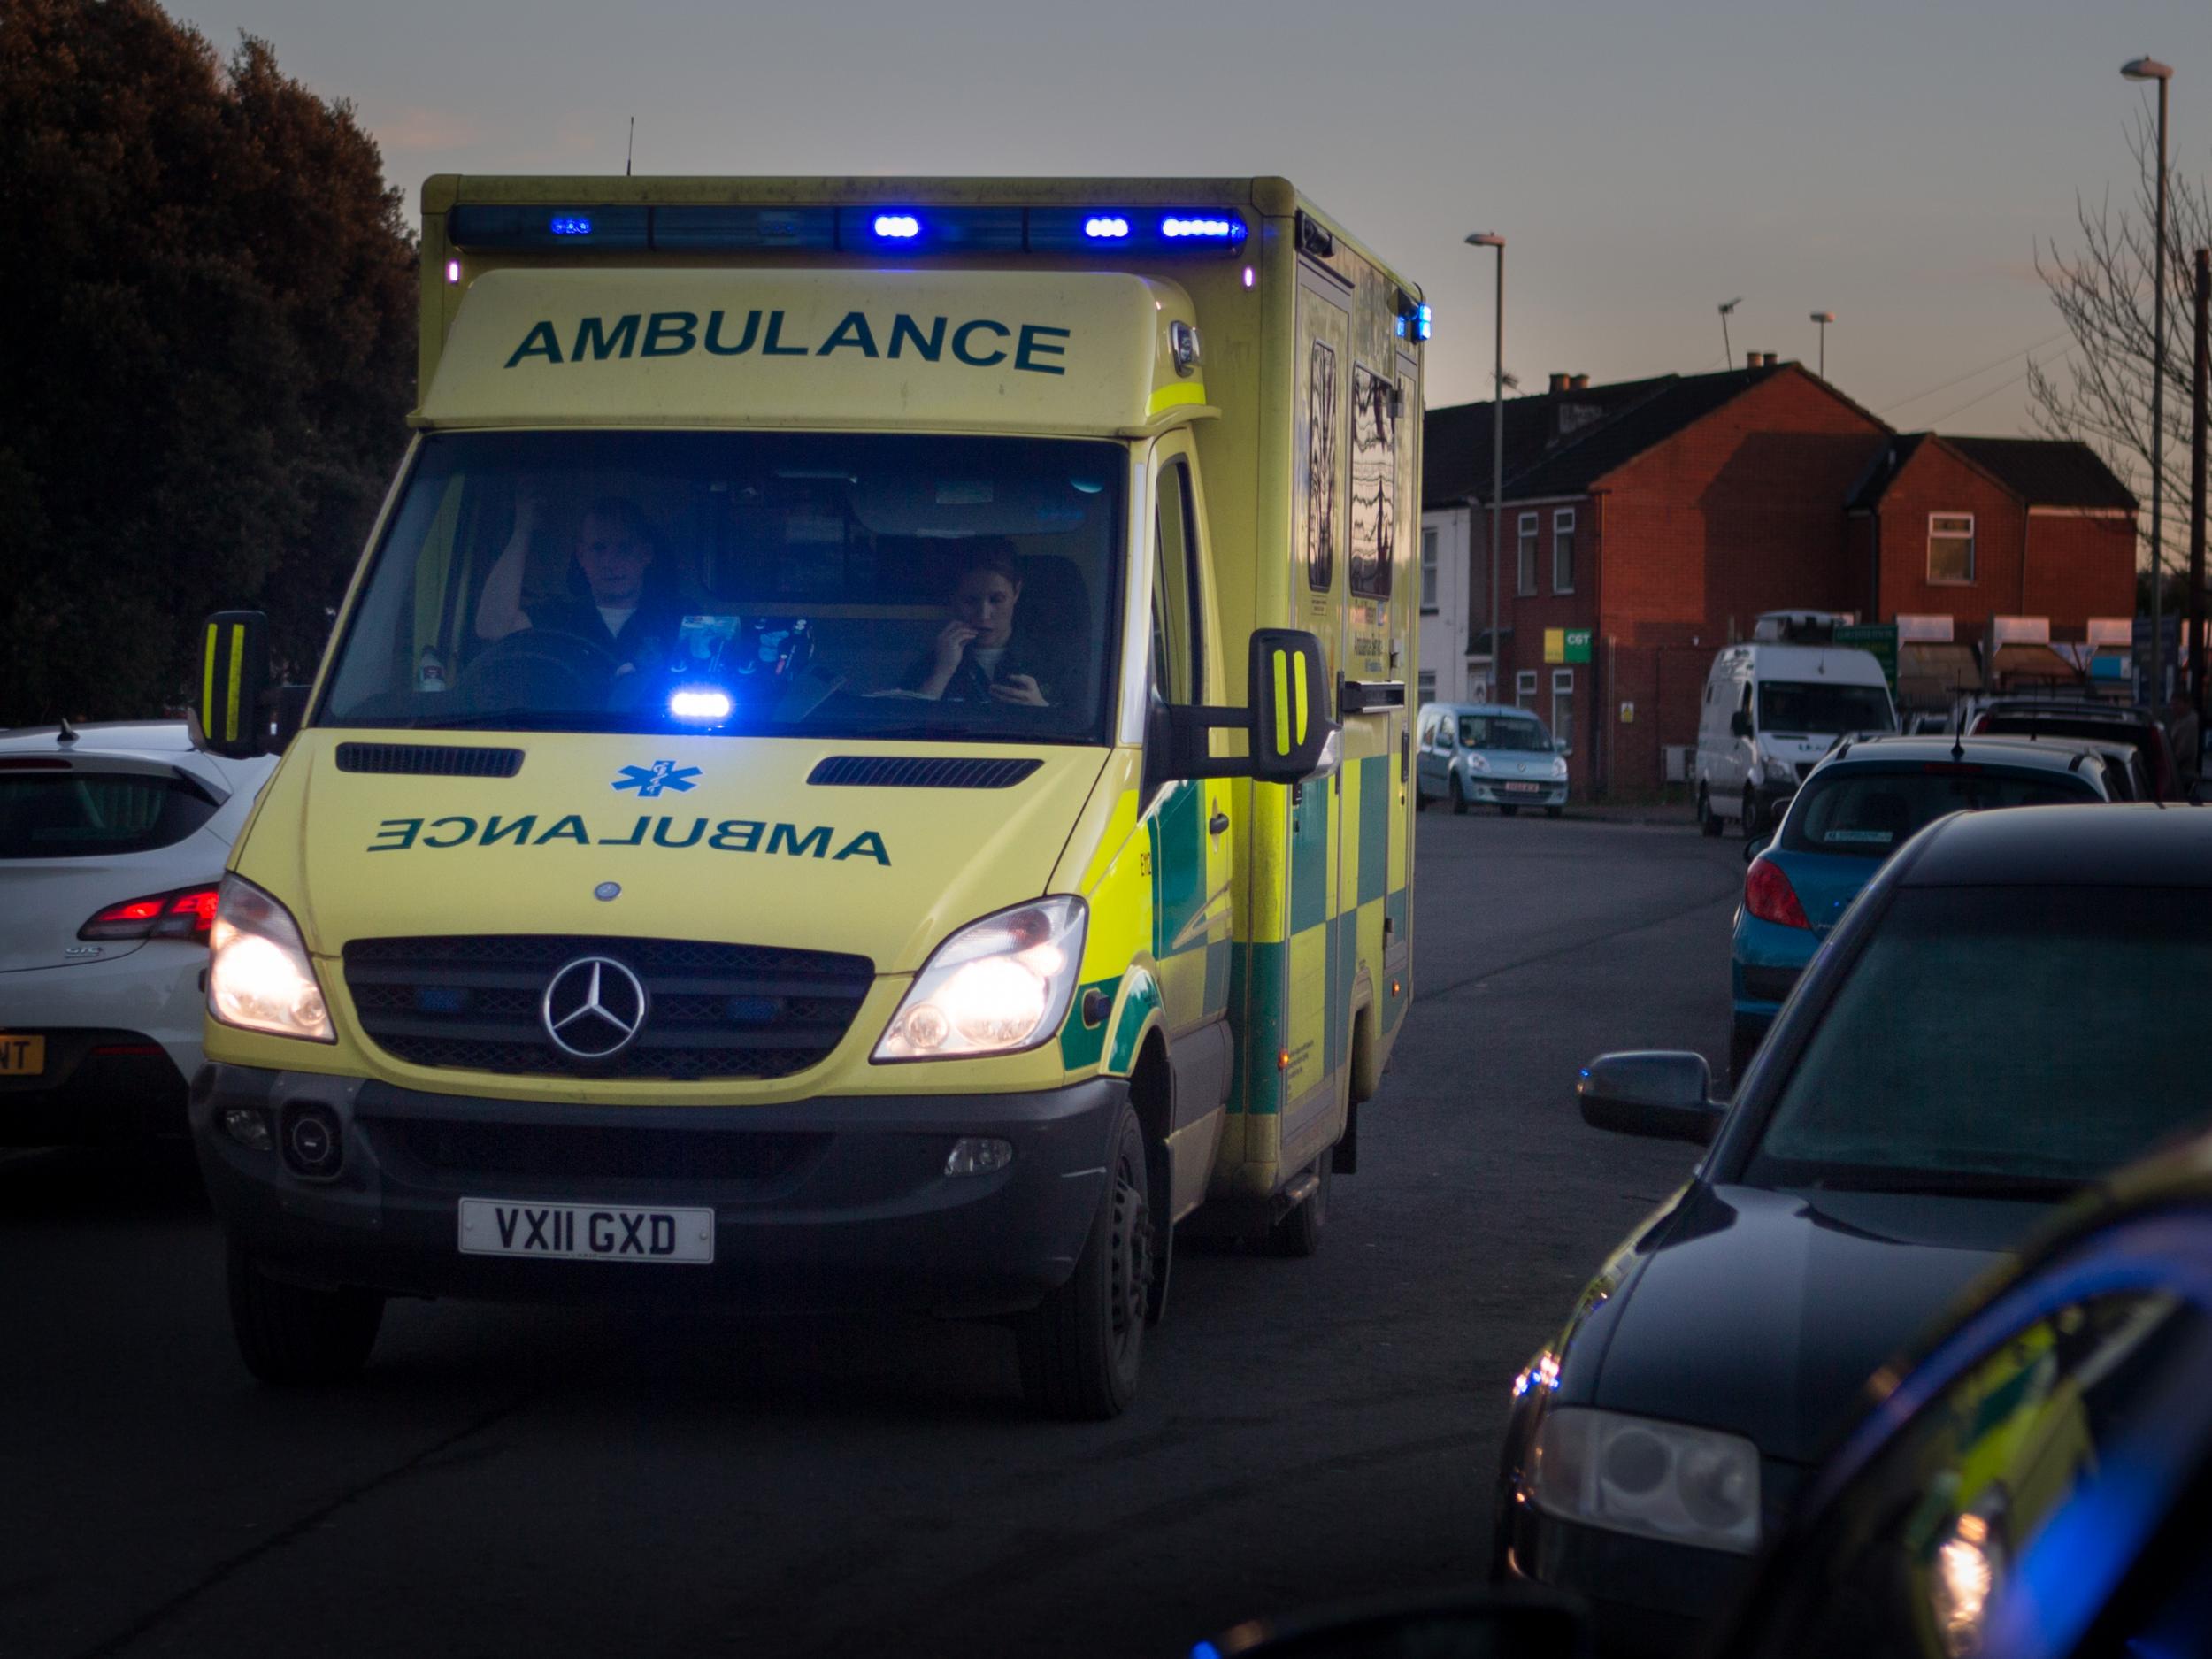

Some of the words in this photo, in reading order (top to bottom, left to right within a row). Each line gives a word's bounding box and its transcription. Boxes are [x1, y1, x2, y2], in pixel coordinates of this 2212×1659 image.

[503, 311, 1071, 375] AMBULANCE
[495, 1207, 573, 1251] VX11
[588, 1212, 675, 1255] GXD
